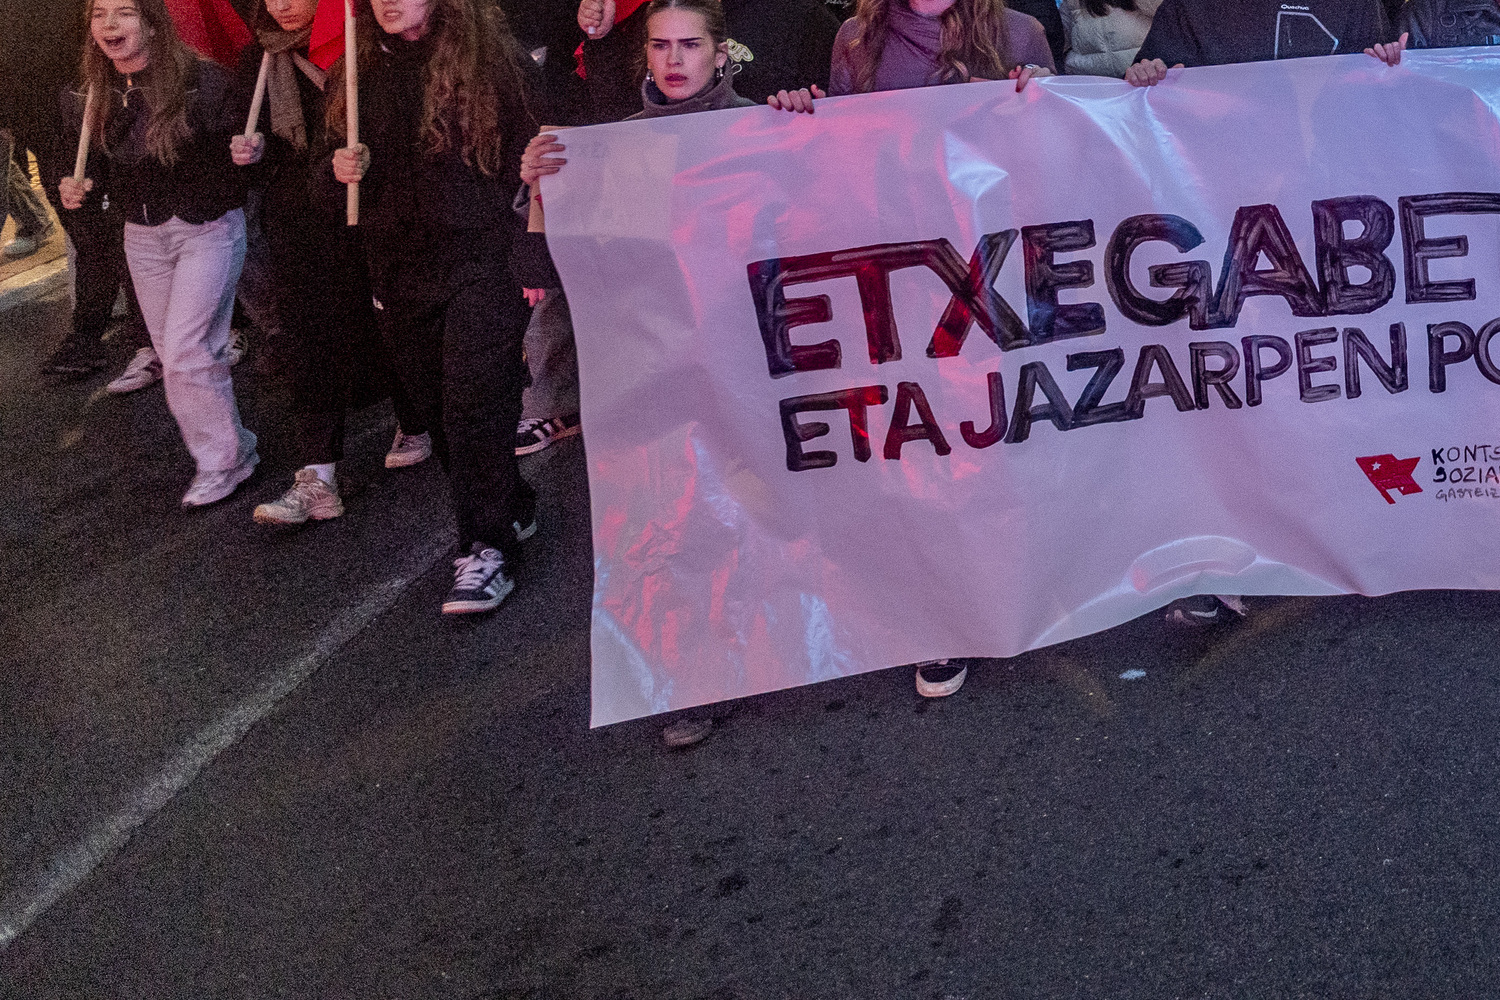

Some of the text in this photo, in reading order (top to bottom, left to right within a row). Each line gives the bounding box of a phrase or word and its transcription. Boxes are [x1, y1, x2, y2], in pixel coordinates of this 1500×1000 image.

[779, 383, 952, 472] ETA
[959, 321, 1409, 449] JAZARPEN
[1435, 486, 1500, 501] GASTEIZ
